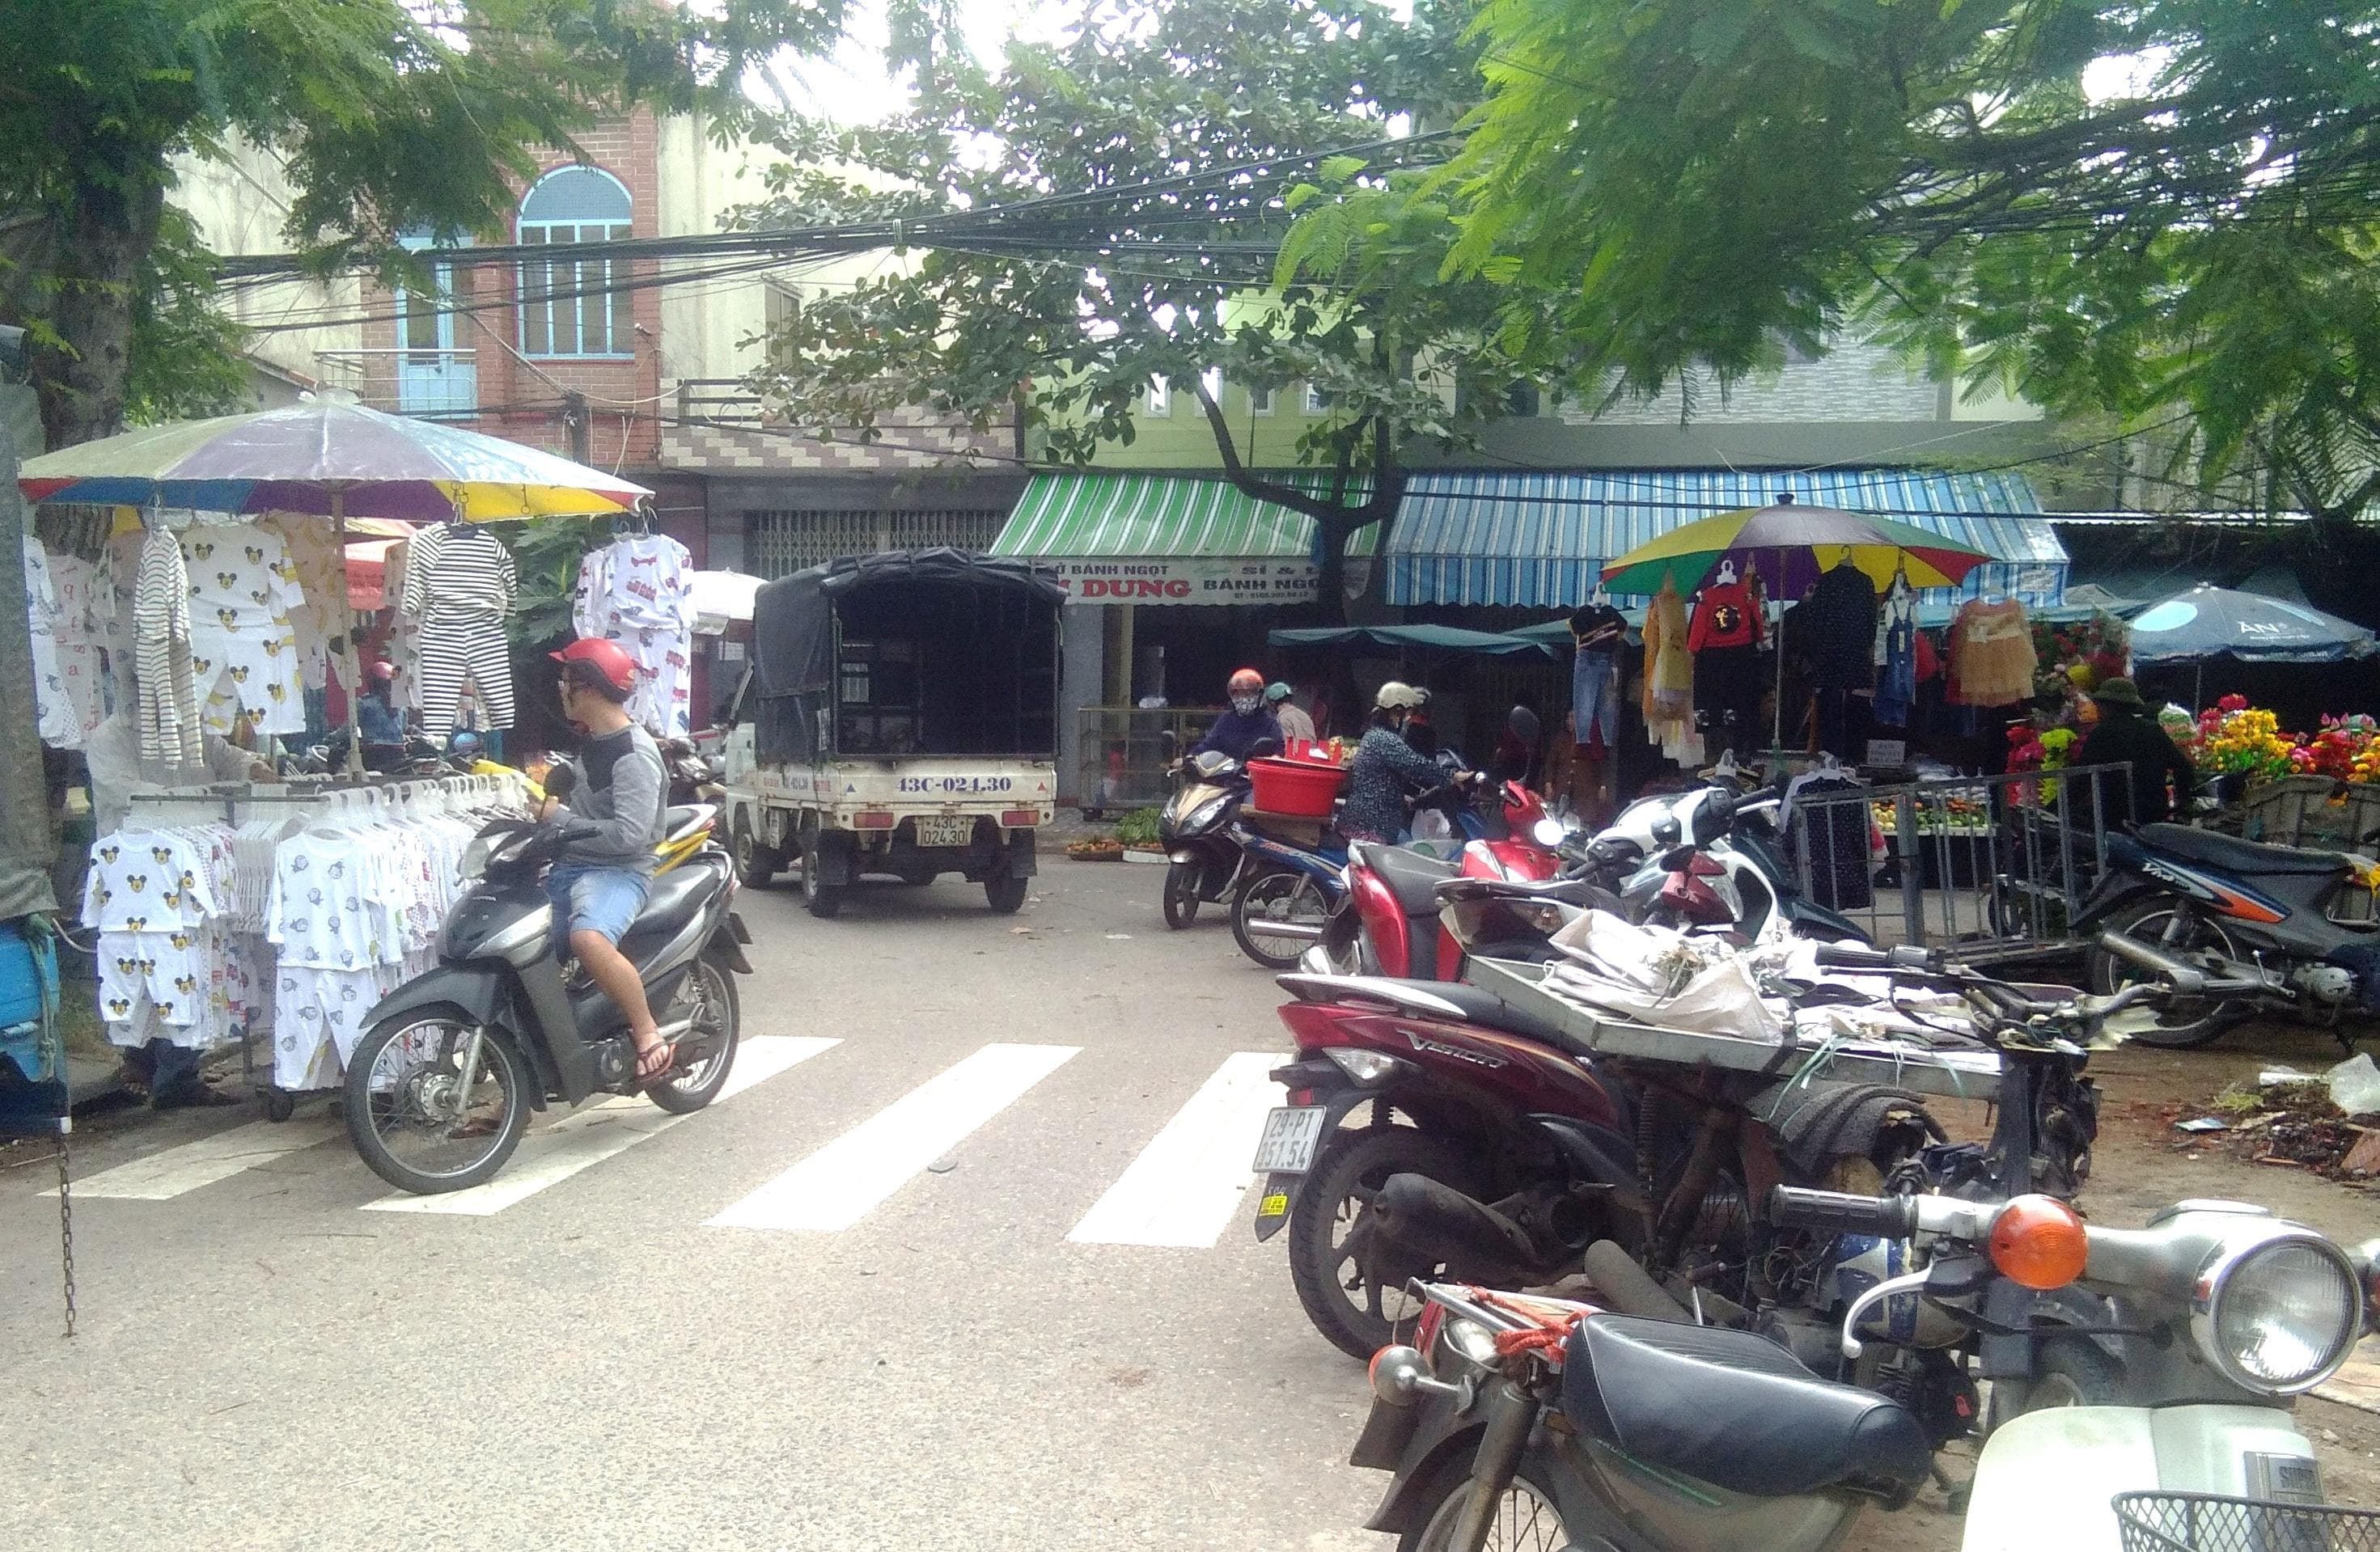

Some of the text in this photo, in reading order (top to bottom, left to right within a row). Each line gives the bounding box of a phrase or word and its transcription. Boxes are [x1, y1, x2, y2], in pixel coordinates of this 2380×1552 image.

[1071, 563, 1118, 575] BÁNH
[1124, 565, 1169, 577] NGỌT
[1081, 578, 1192, 598] DUNG
[1203, 577, 1267, 590] BÁNH
[896, 776, 1012, 793] 43C-024.30
[933, 814, 957, 830] 43C
[923, 829, 966, 844] 024.30
